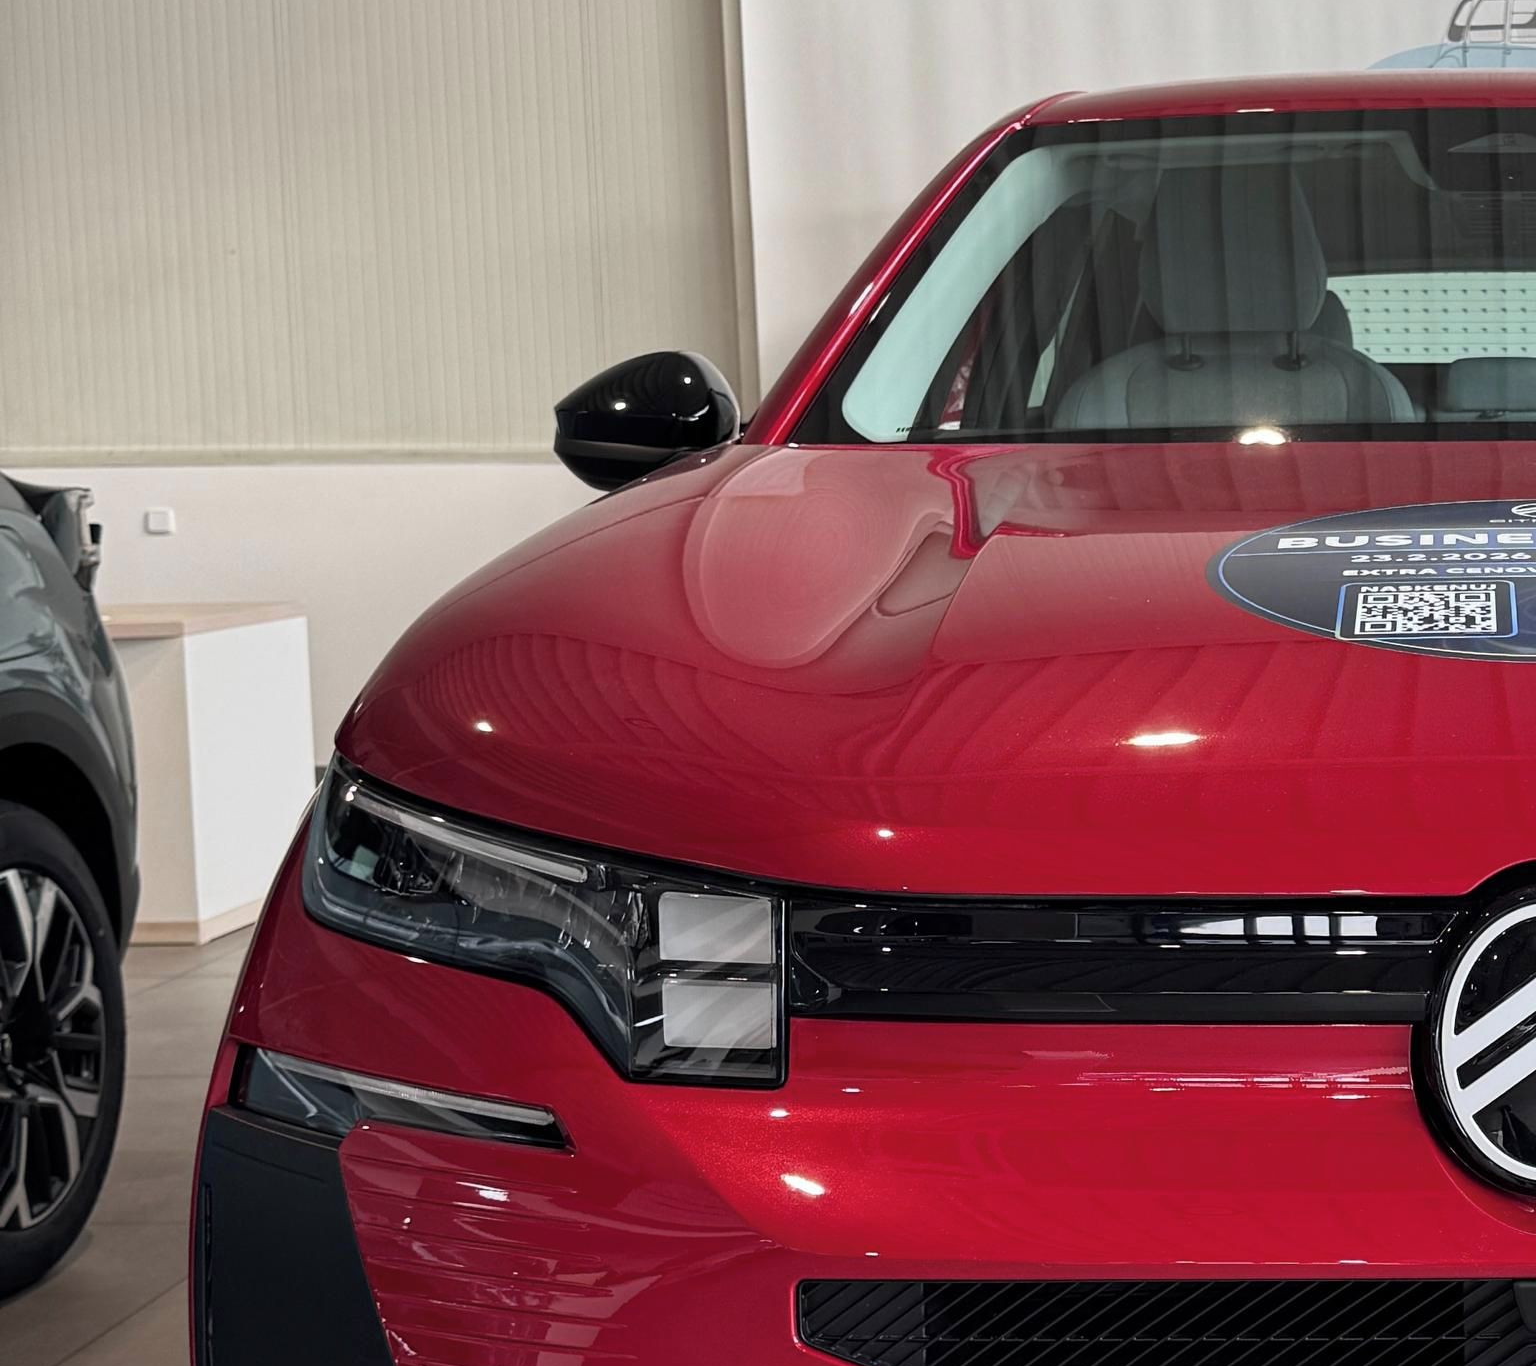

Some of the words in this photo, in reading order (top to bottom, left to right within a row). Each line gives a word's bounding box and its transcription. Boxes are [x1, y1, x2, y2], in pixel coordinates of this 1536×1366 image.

[1351, 551, 1532, 563] 23.2.2026
[1342, 567, 1438, 576] EXTRA
[1360, 584, 1497, 593] NASKENUJ
